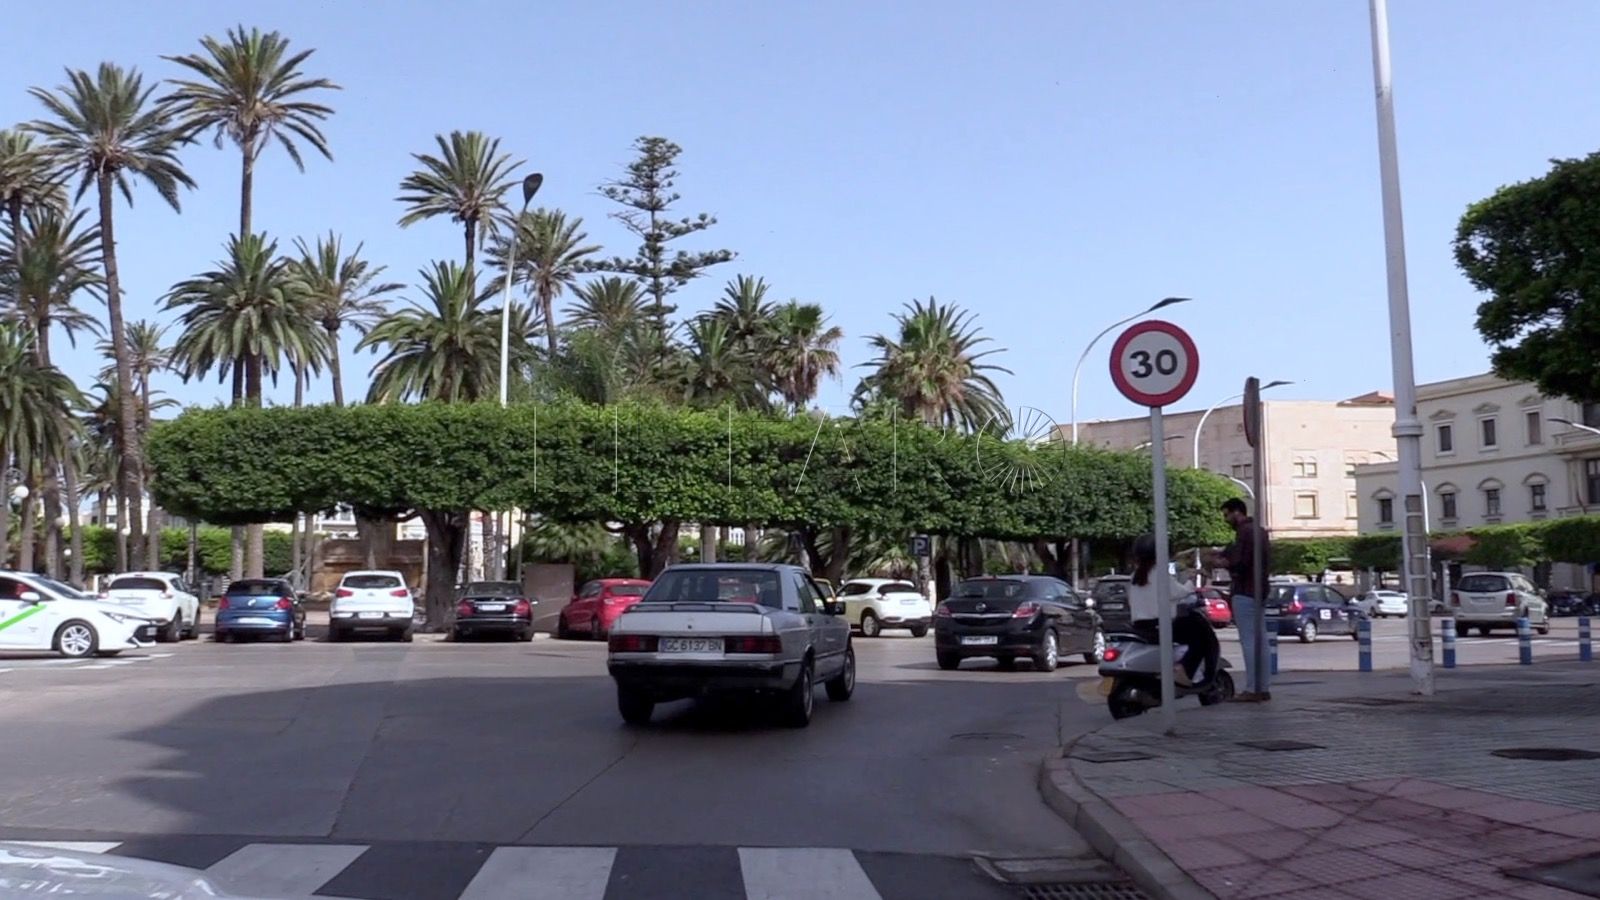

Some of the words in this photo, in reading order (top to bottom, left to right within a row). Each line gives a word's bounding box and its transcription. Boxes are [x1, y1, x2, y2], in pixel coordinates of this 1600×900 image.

[1129, 349, 1178, 378] 30
[914, 539, 926, 554] P
[666, 639, 679, 651] GC
[680, 639, 706, 651] 6137
